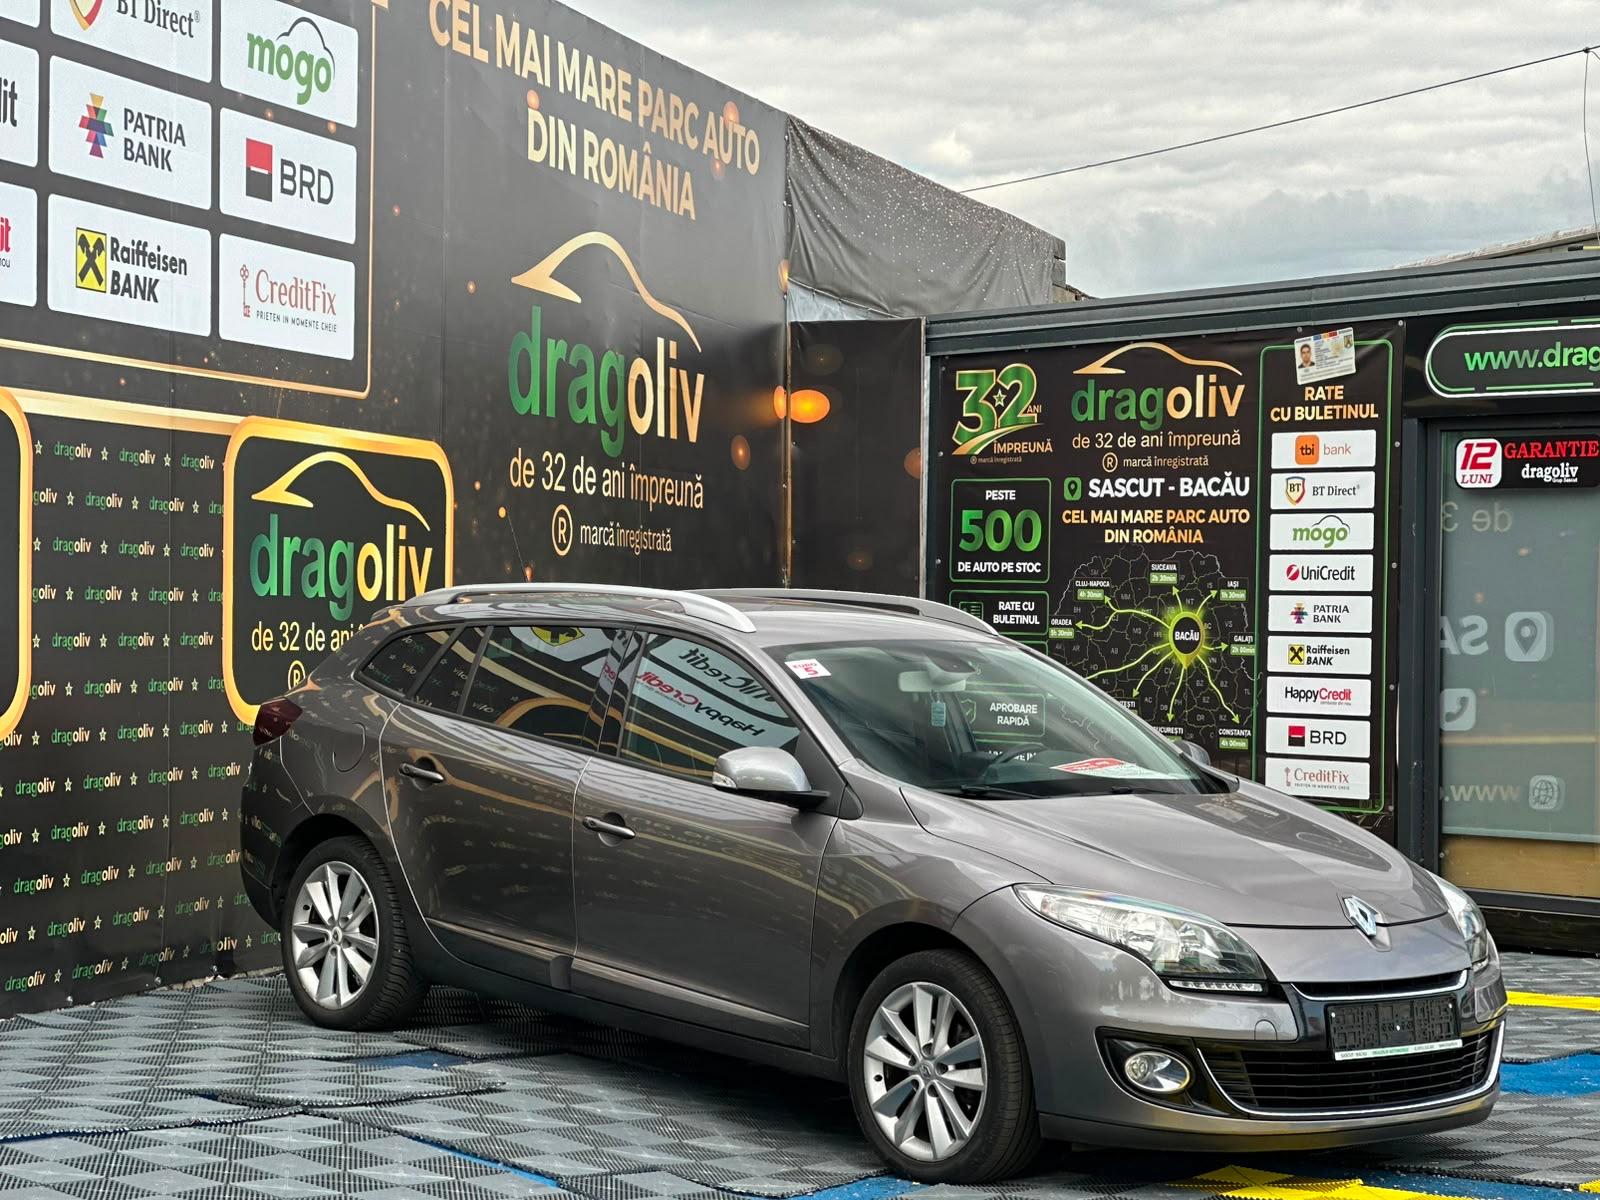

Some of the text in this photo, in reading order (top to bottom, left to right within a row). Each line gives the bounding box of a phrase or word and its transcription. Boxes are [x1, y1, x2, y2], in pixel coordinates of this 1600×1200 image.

[247, 32, 332, 105] mogo
[429, 0, 760, 175] CEL MAI MARE PARC AUTO
[123, 107, 187, 147] PATRIA
[123, 137, 173, 172] BANK
[527, 108, 696, 220] DIN ROMÂNIA
[280, 158, 334, 206] BRD
[110, 236, 188, 276] Raiffeisen
[110, 270, 159, 303] BANK
[255, 269, 337, 316] CreditFix
[256, 310, 337, 333] PRIETEN IN MOMENTE CHEIE
[508, 305, 704, 458] dragoliv
[1071, 374, 1246, 431] dragoliv
[1304, 385, 1345, 401] RATE
[952, 363, 1042, 446] 32 ANI
[1270, 403, 1379, 422] CU BULETINUL
[993, 438, 1053, 454] ÎMPREUNĂ
[1072, 429, 1241, 451] de 32 de ani împreună
[1299, 443, 1352, 456] tbi bank
[55, 441, 215, 471] dragoliv dragoliv dragoliv
[1123, 455, 1152, 467] marcă
[1154, 454, 1209, 470] înregistrată
[1460, 440, 1600, 471] 12 GARANTIE
[509, 447, 704, 511] de 32 de ani împreună
[1460, 473, 1493, 485] LUNI
[1521, 462, 1579, 482] dragoliv
[1088, 477, 1165, 498] SASCUT
[1179, 471, 1251, 497] BACĂU
[1289, 482, 1302, 493] BT
[1312, 486, 1326, 497] BT
[85, 492, 185, 514] dragoliv dragoliv
[985, 490, 1016, 500] PESTE
[1062, 508, 1250, 524] CEL MAI MARE PARC AUTO
[580, 521, 615, 546] marcă
[616, 522, 672, 555] înregistrată
[959, 509, 1042, 552] 500
[1104, 525, 1204, 543] DIN ROMÂNIA
[1292, 526, 1349, 548] mogo
[52, 536, 214, 560] dragoliv dragoliv dragoliv
[250, 513, 433, 621] dragoliv
[958, 562, 1041, 573] DE AUTO PE STOC
[1151, 563, 1177, 571] SUCEAVA
[1301, 565, 1355, 581] UniCredit
[84, 585, 184, 604] dragoliv dragoliv
[998, 601, 1034, 611] RATE CU
[1313, 604, 1350, 614] PATRIA
[993, 614, 1040, 624] BULETINUL
[1051, 618, 1073, 626] ORADEA
[1313, 614, 1342, 624] BANK
[52, 631, 214, 650] dragoliv dragoliv dragoliv
[251, 621, 274, 651] de
[279, 621, 300, 651] 32
[305, 622, 326, 652] de
[1174, 630, 1200, 641] BACĂU
[1306, 645, 1350, 655] Raiffeisen
[1306, 656, 1333, 666] BANK
[84, 677, 184, 697] dragoliv dragoliv
[1284, 686, 1352, 703] HappyCredit
[990, 702, 1038, 714] APROBARE
[997, 715, 1030, 727] RAPIDĂ
[51, 720, 214, 746] dragoliv dragoliv dragoliv
[1310, 730, 1347, 745] BRD
[15, 762, 241, 797] dragoliv dragoliv dragoliv dragoliv
[1294, 767, 1349, 784] CreditFix
[51, 808, 214, 842] dragoliv dragoliv dragoliv
